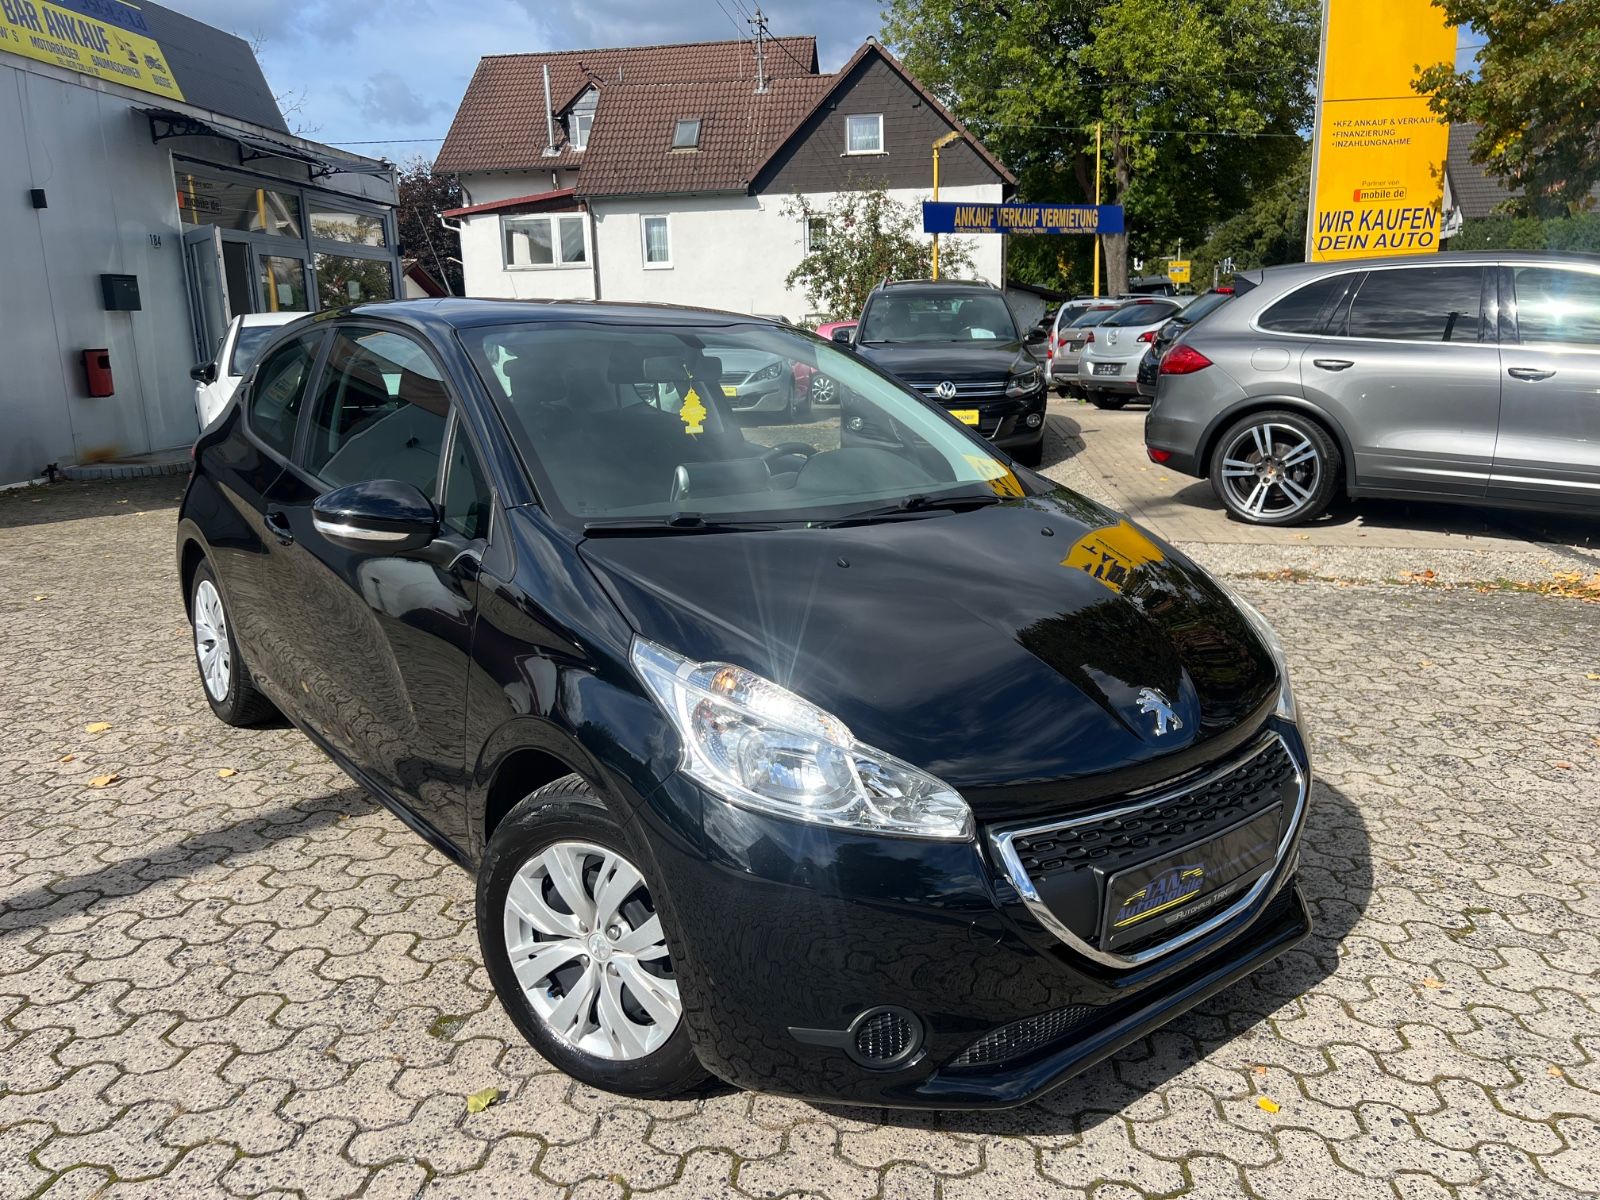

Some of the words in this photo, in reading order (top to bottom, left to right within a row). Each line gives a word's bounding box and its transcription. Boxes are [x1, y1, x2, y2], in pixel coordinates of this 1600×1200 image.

[2, 0, 44, 33] BAR
[42, 6, 110, 56] ANKAUF
[29, 35, 80, 61] MOTORRÄDER
[1336, 120, 1353, 128] KFZ
[1354, 119, 1388, 127] ANKAUF
[1397, 116, 1436, 125] VERKAUF
[1335, 129, 1396, 138] FINANZIERUNG
[1335, 138, 1411, 148] INZAHLUNGNAHME
[954, 206, 994, 227] ANKAUF
[996, 207, 1039, 227] VERKAUF
[1041, 207, 1098, 228] VERMIETUNG
[1318, 210, 1354, 233] WIR
[1358, 207, 1438, 232] KAUFEN
[149, 233, 162, 246] 184
[1318, 234, 1369, 250] DEIN
[1373, 232, 1434, 249] AUTO
